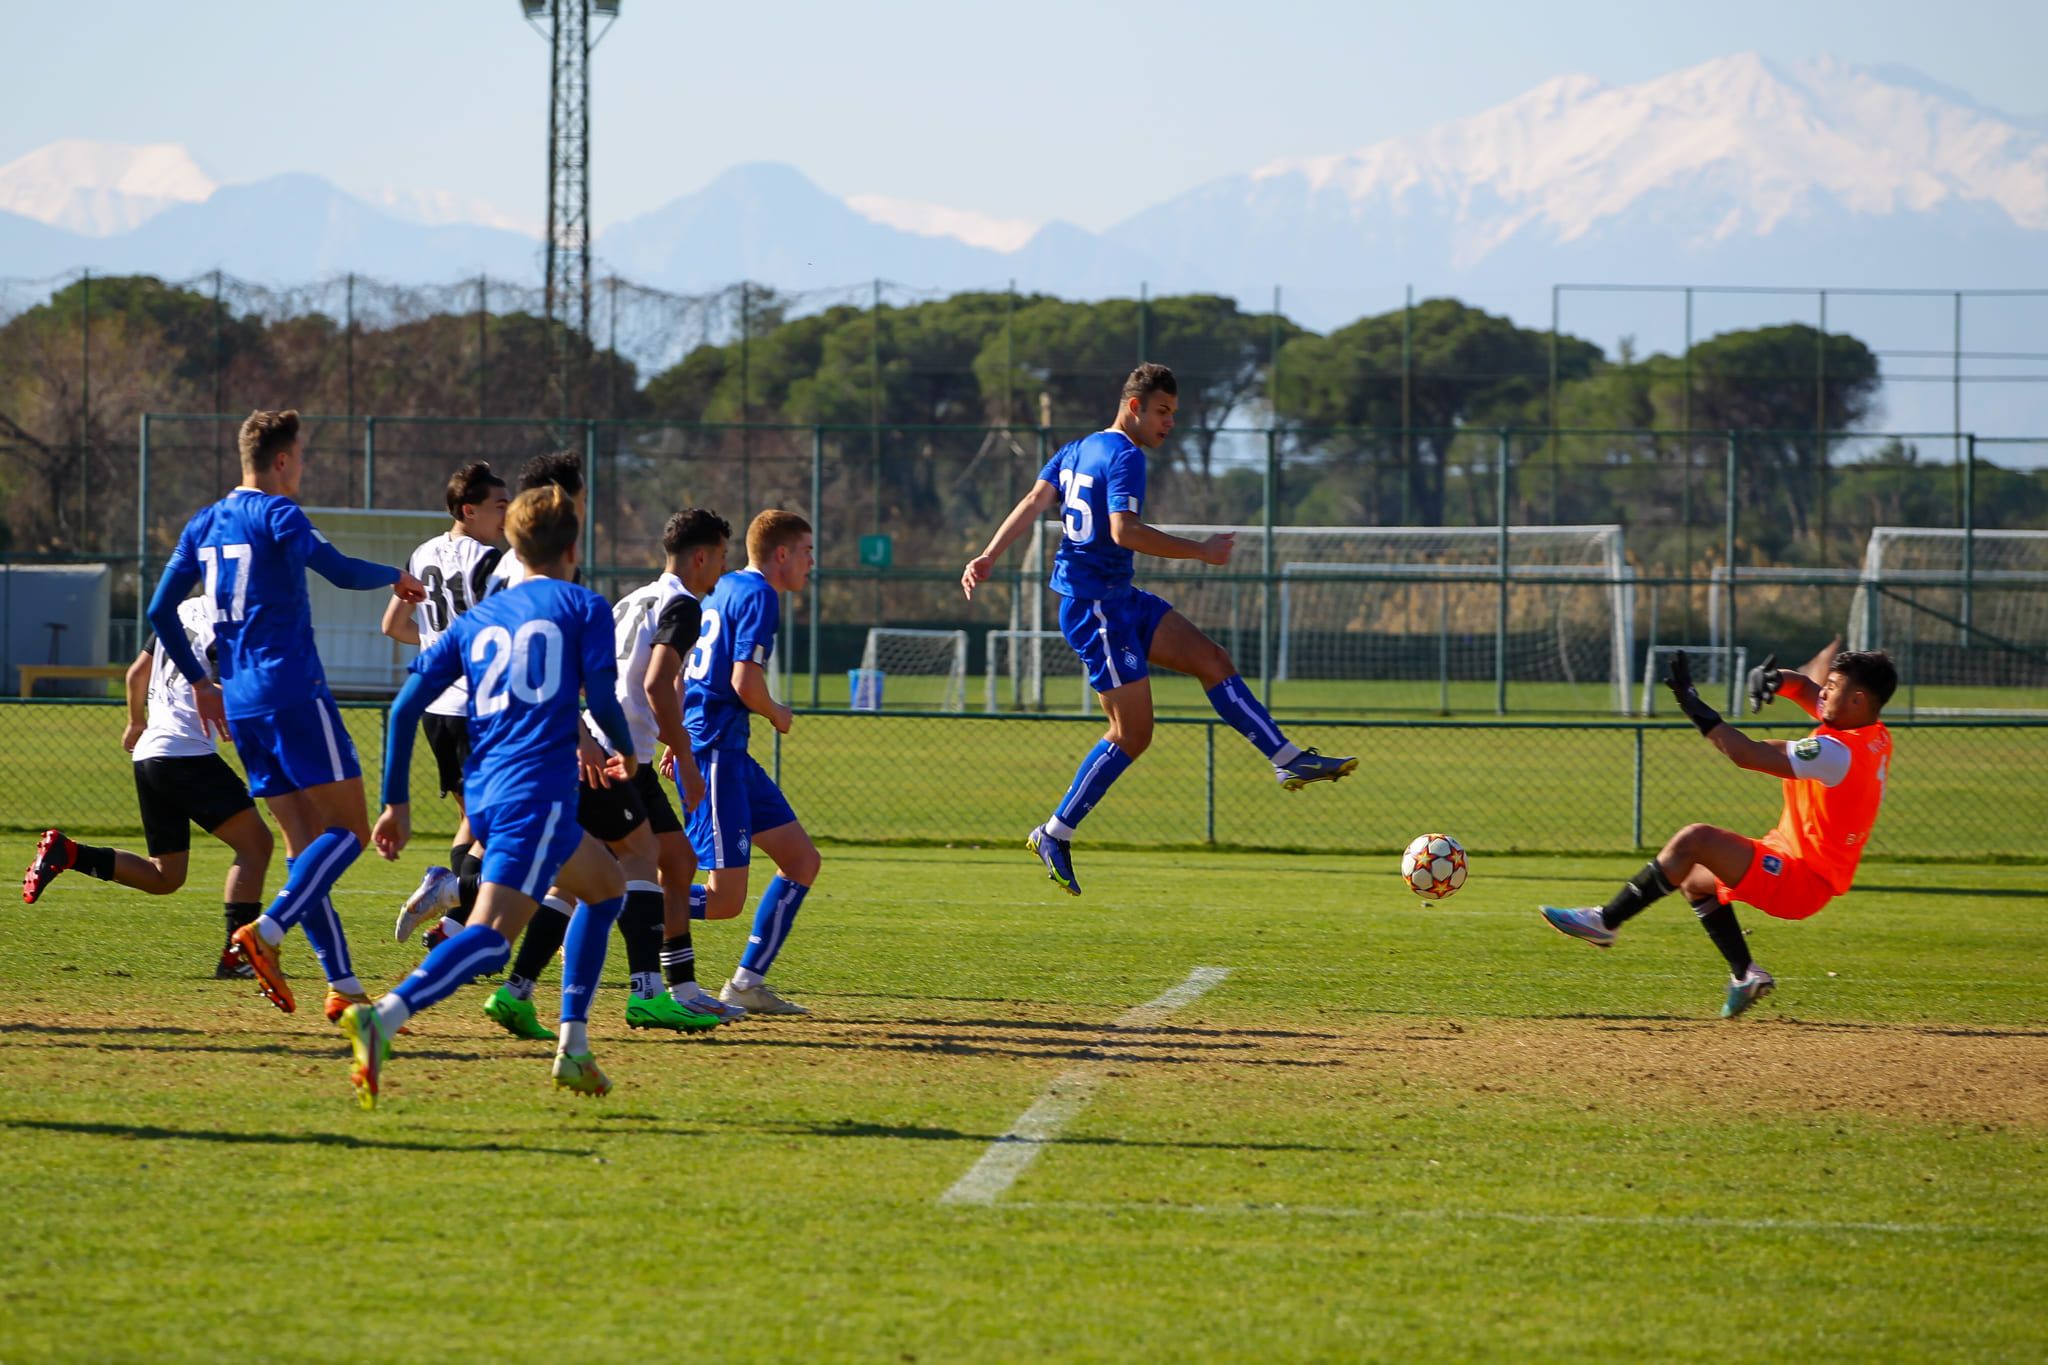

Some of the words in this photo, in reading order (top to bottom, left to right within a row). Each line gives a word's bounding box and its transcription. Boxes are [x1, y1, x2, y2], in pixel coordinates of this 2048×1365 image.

[198, 544, 252, 621] 17
[869, 537, 884, 561] J
[421, 565, 468, 632] 31
[471, 619, 563, 717] 20
